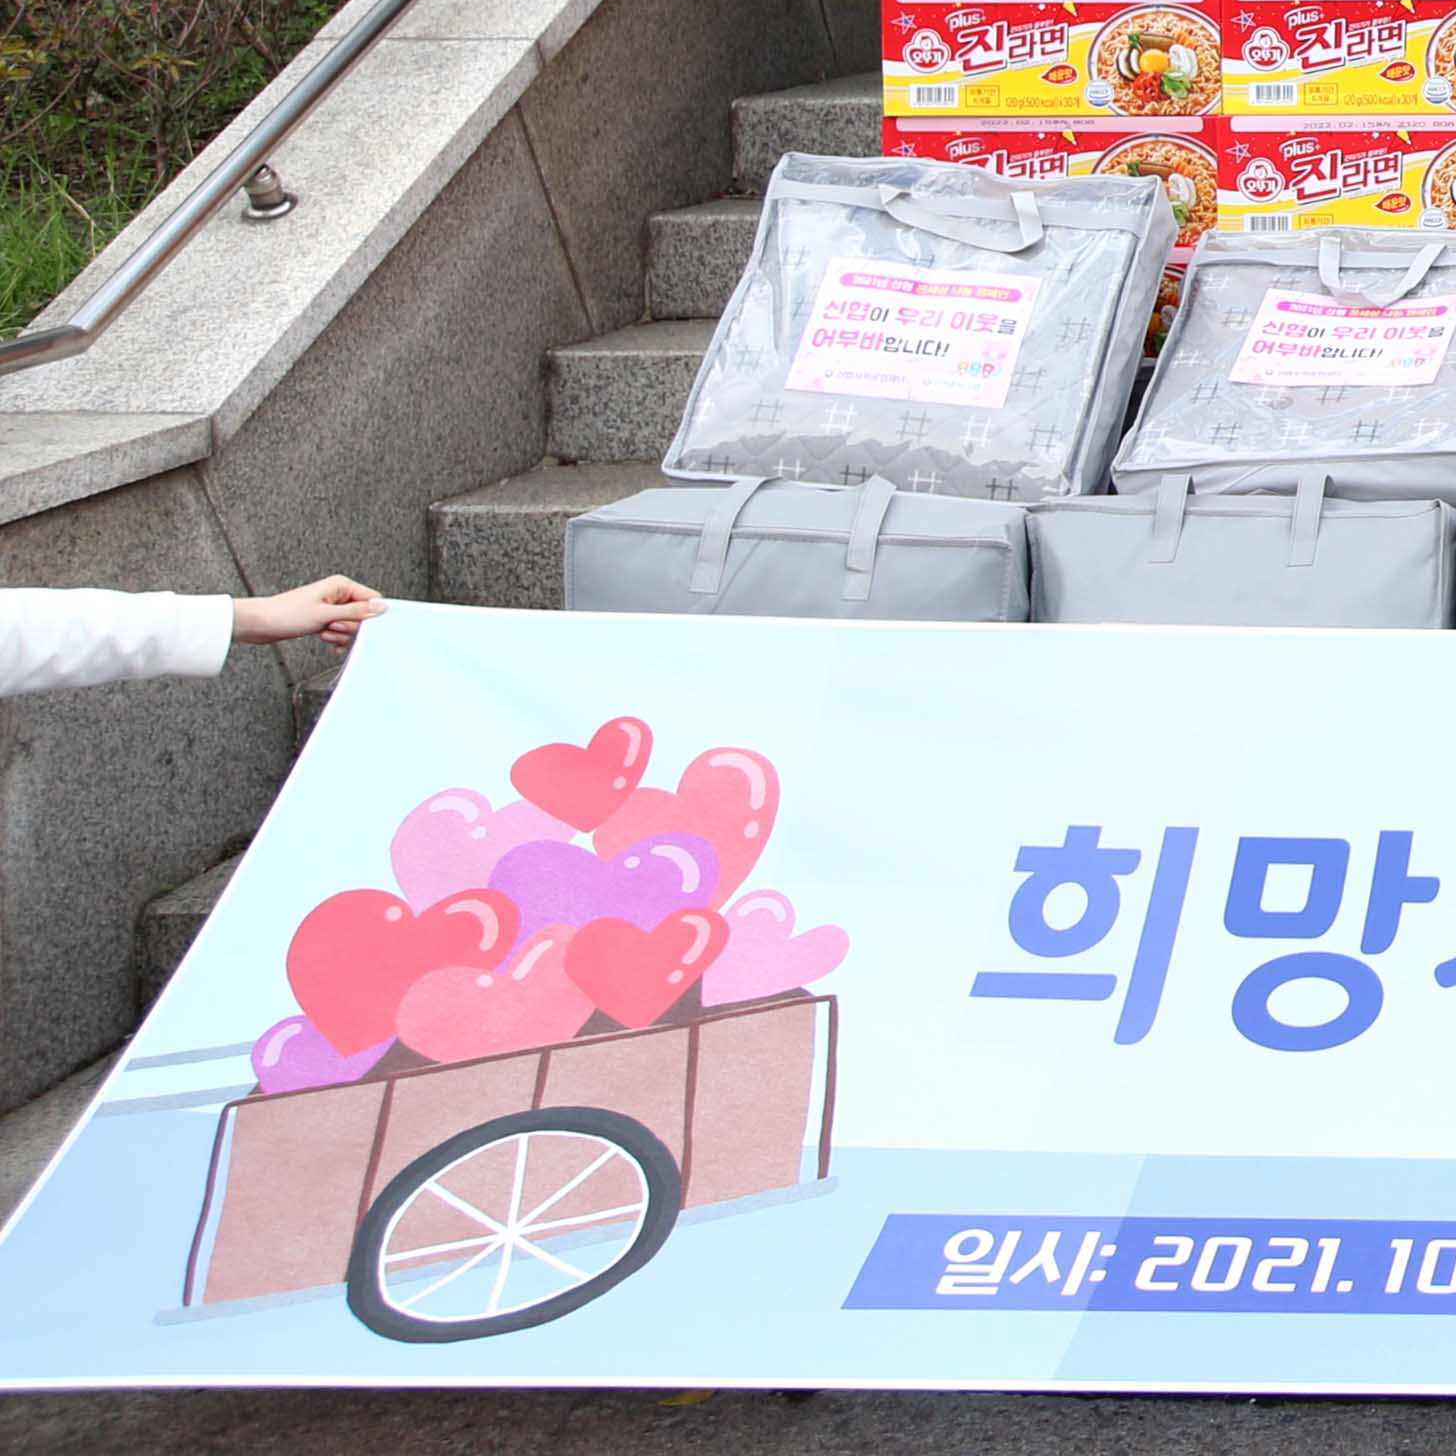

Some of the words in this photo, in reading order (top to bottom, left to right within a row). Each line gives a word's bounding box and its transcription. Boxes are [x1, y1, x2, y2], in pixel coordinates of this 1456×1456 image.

[956, 22, 1068, 75] 진라면
[1294, 19, 1406, 72] 진라면
[1288, 150, 1402, 204] 진라면
[937, 1230, 1115, 1296] 일시:
[1135, 1235, 1352, 1292] 2021.
